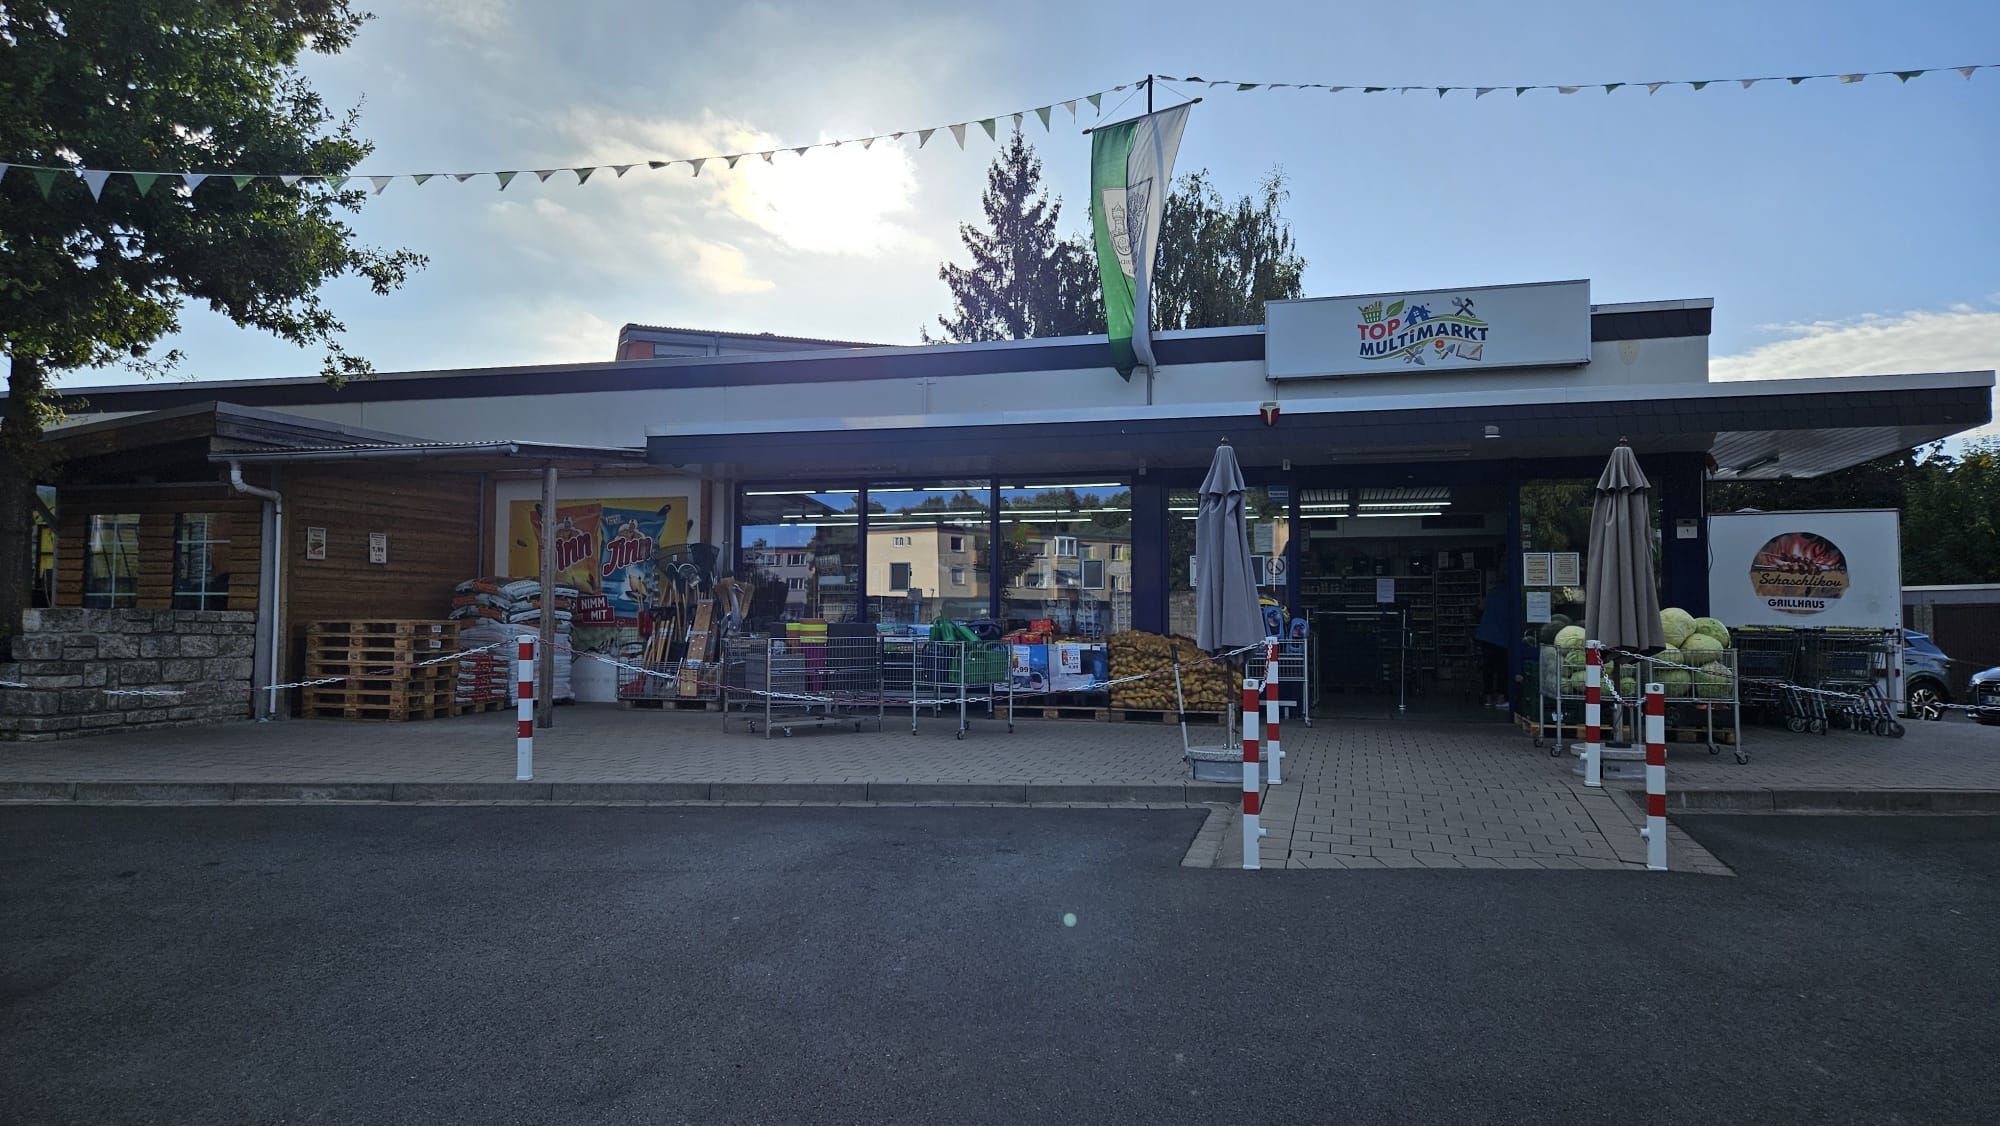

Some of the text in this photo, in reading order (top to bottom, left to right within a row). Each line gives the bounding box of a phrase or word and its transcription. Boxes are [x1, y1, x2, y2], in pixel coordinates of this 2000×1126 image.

[1357, 318, 1401, 341] TOP
[556, 533, 592, 571] inn
[581, 597, 606, 610] NIMM
[1767, 598, 1825, 609] GRILLHAUS
[590, 609, 608, 621] MIT
